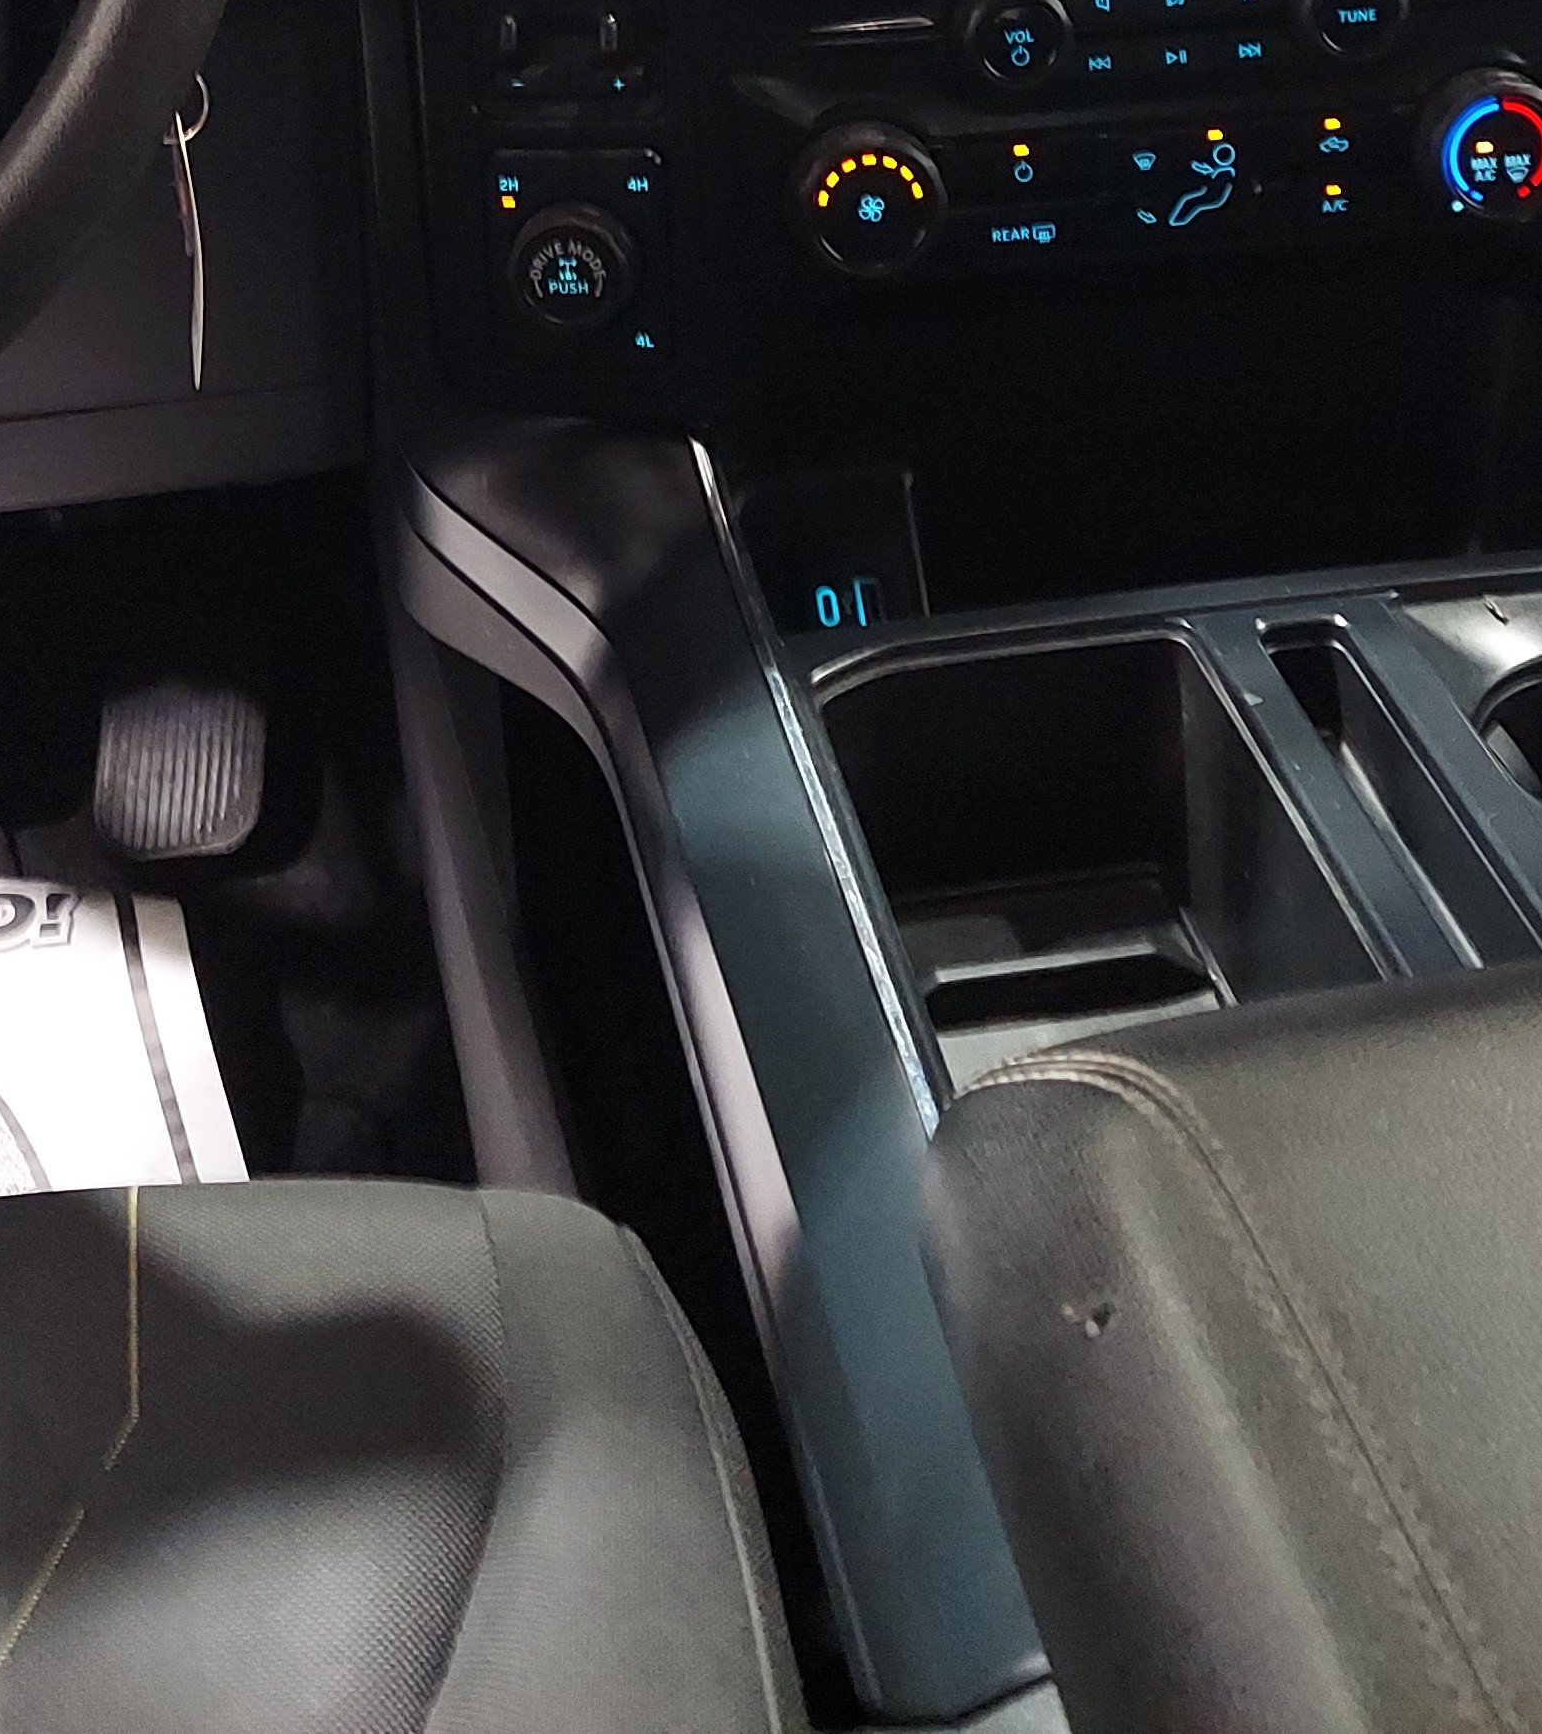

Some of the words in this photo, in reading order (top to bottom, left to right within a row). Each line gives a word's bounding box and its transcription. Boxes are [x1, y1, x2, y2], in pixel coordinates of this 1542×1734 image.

[1337, 7, 1378, 23] TUNE
[1004, 29, 1035, 44] VOL
[498, 175, 519, 192] 2H
[627, 176, 649, 192] 4H
[1321, 199, 1349, 214] A/C
[992, 227, 1030, 244] REAR
[530, 239, 564, 280] DRIVE
[567, 238, 606, 279] MODE
[548, 279, 589, 295] PUSH
[635, 331, 655, 348] 4L
